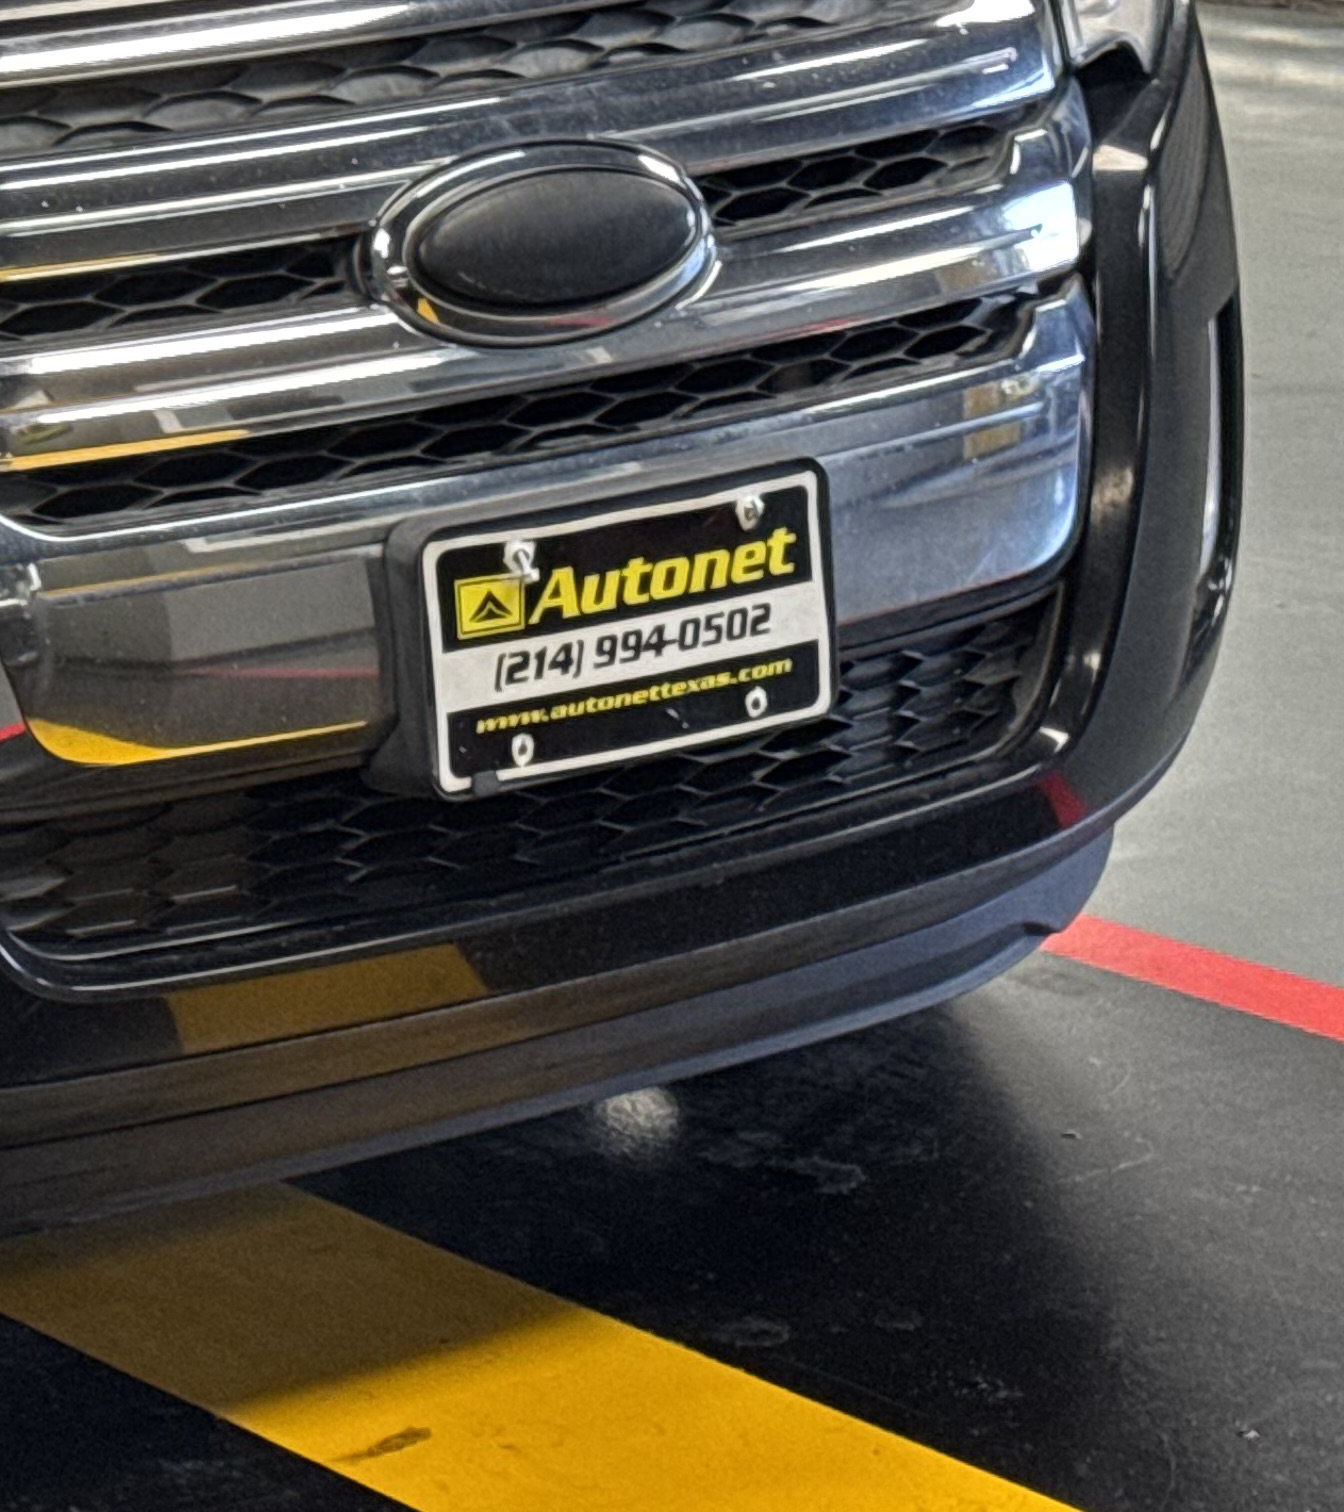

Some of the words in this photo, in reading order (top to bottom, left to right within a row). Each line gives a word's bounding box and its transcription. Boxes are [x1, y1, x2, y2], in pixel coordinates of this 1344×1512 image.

[529, 526, 796, 625] Autonet
[494, 639, 585, 692] (214)
[593, 603, 772, 669] 994-0502
[476, 657, 793, 734] www.autonettexas.com
